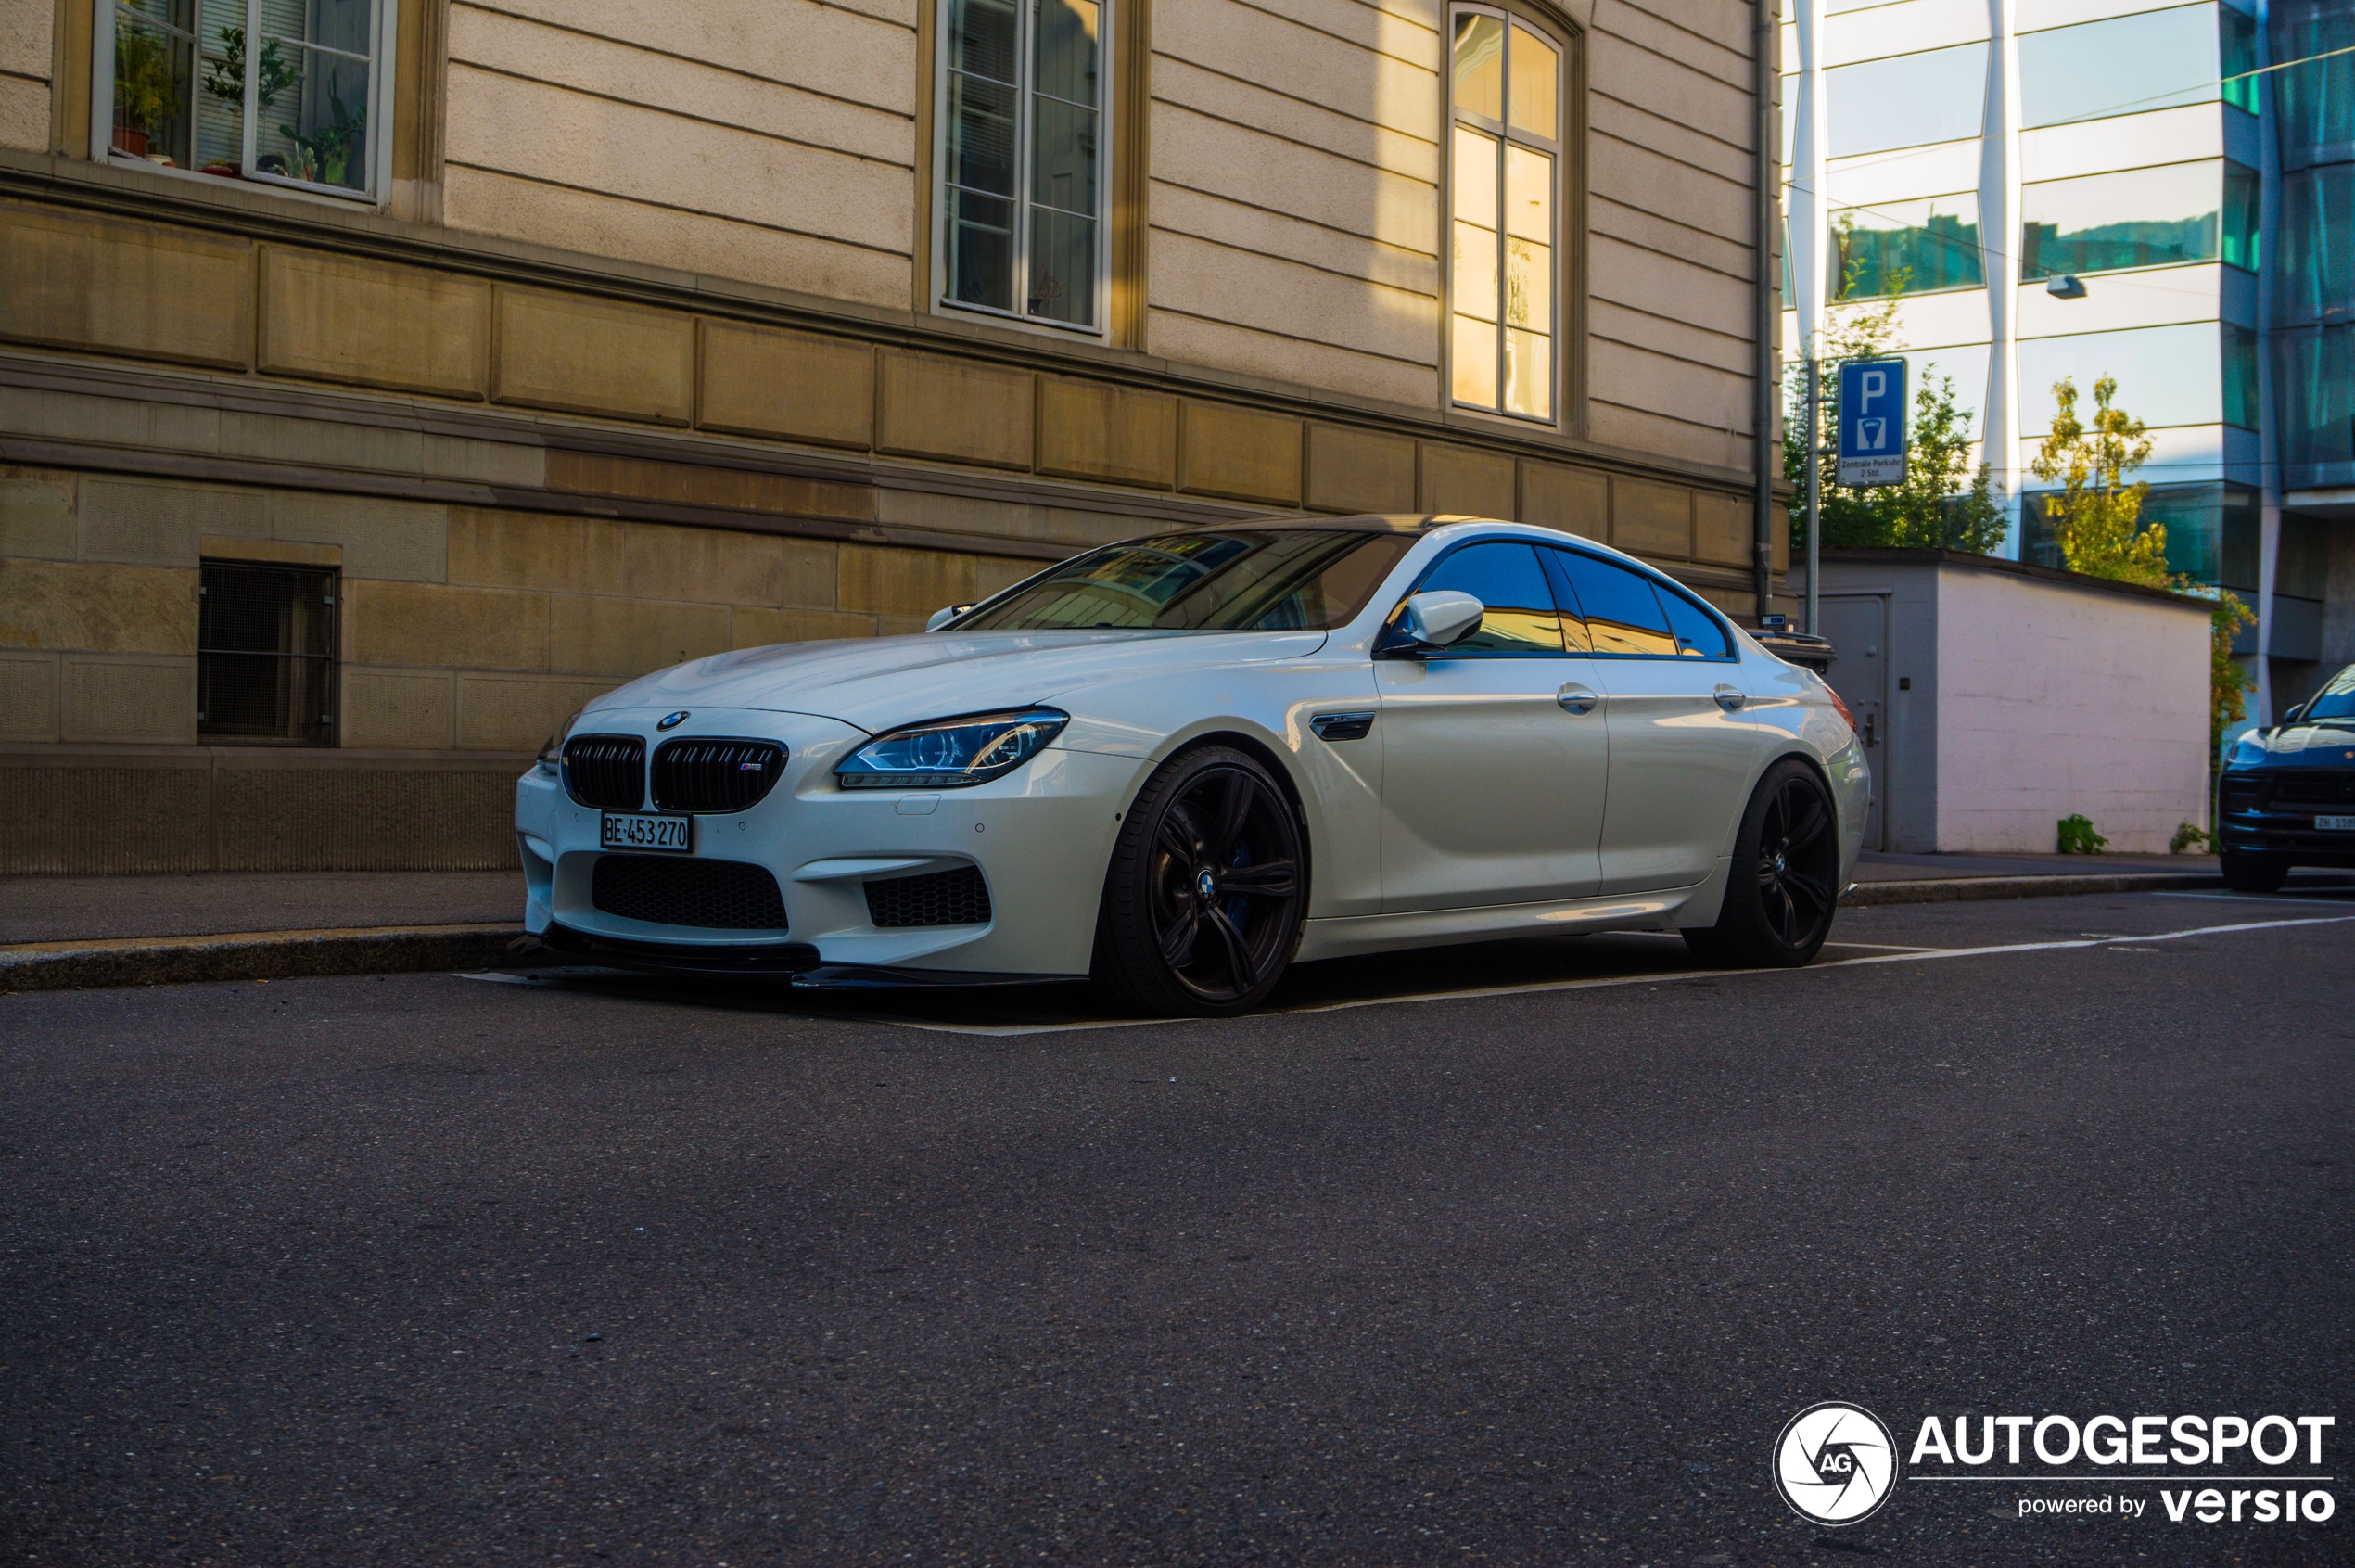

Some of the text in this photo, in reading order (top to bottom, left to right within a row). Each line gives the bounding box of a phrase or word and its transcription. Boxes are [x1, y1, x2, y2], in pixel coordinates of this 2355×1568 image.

[1862, 370, 1886, 414] P
[1841, 458, 1901, 468] Zentrale Parkuhr
[1861, 468, 1881, 478] 2 Std.
